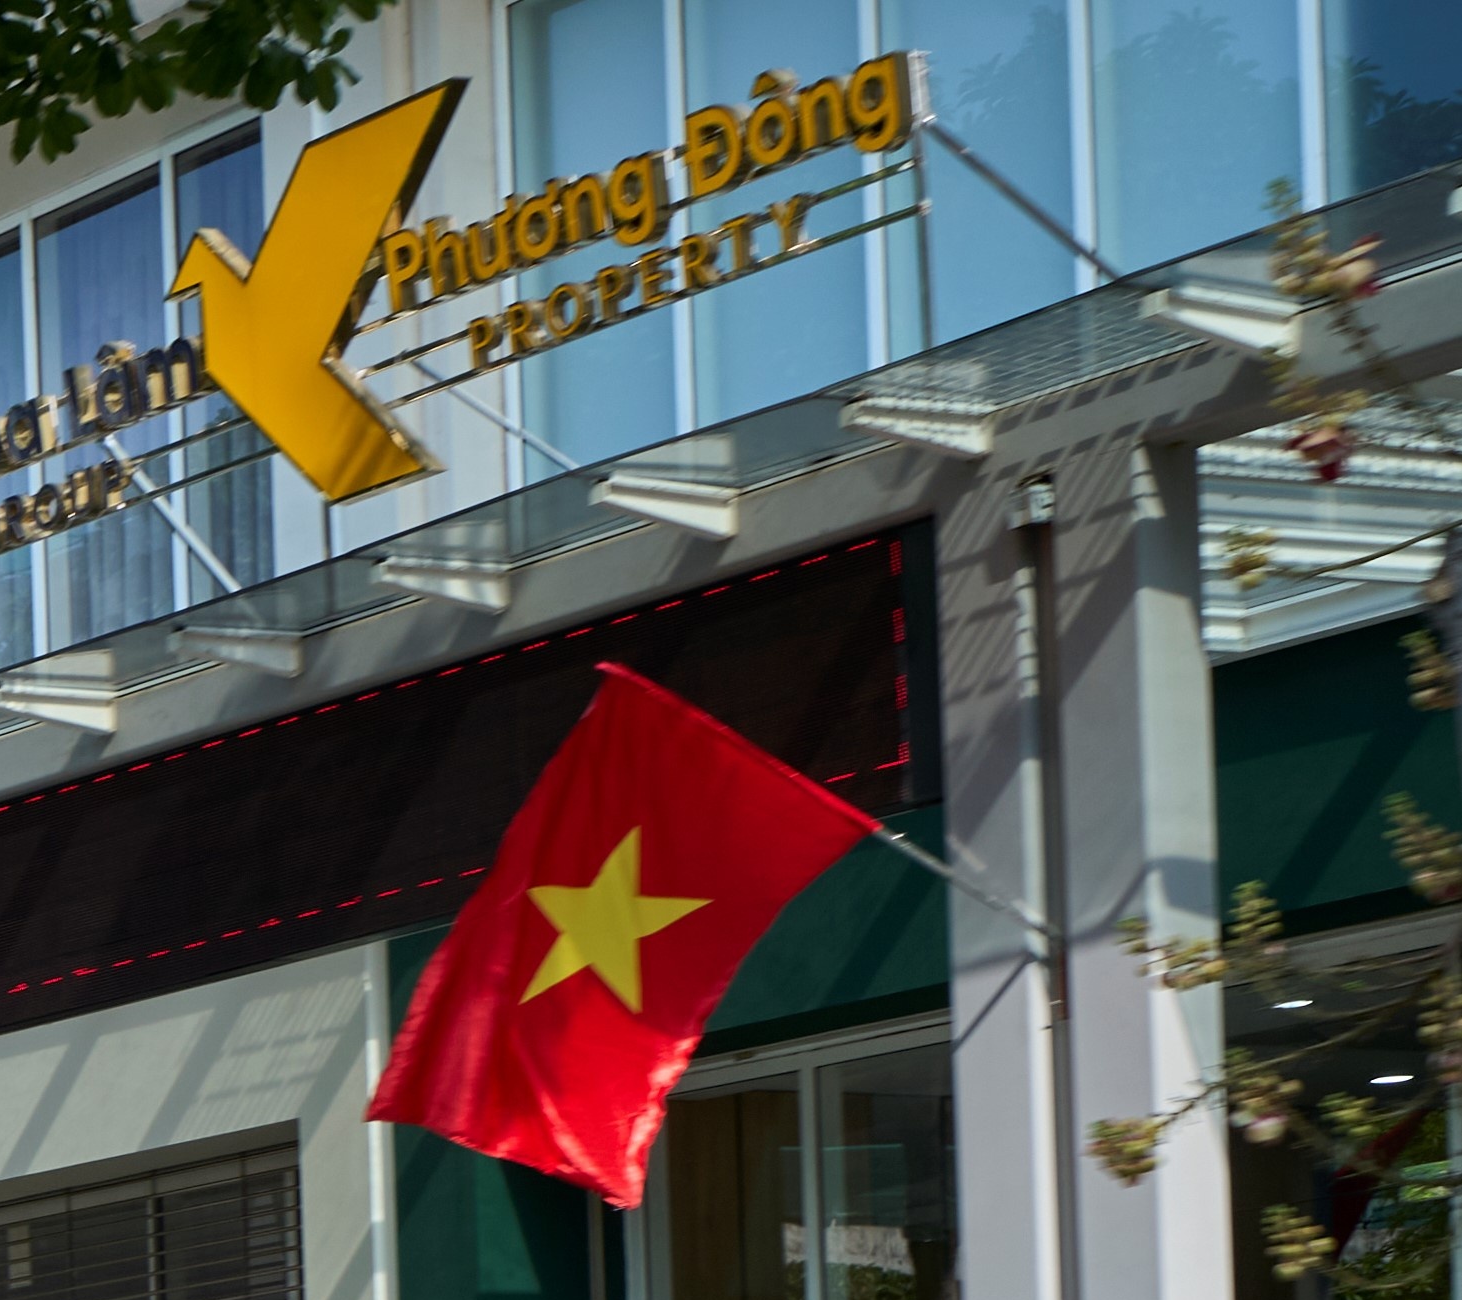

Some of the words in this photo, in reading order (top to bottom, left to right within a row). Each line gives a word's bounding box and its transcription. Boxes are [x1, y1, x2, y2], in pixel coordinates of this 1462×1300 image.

[382, 151, 668, 312] Phương
[685, 48, 911, 197] Đông
[468, 192, 813, 368] PROPERTY
[62, 340, 204, 439] Lâm
